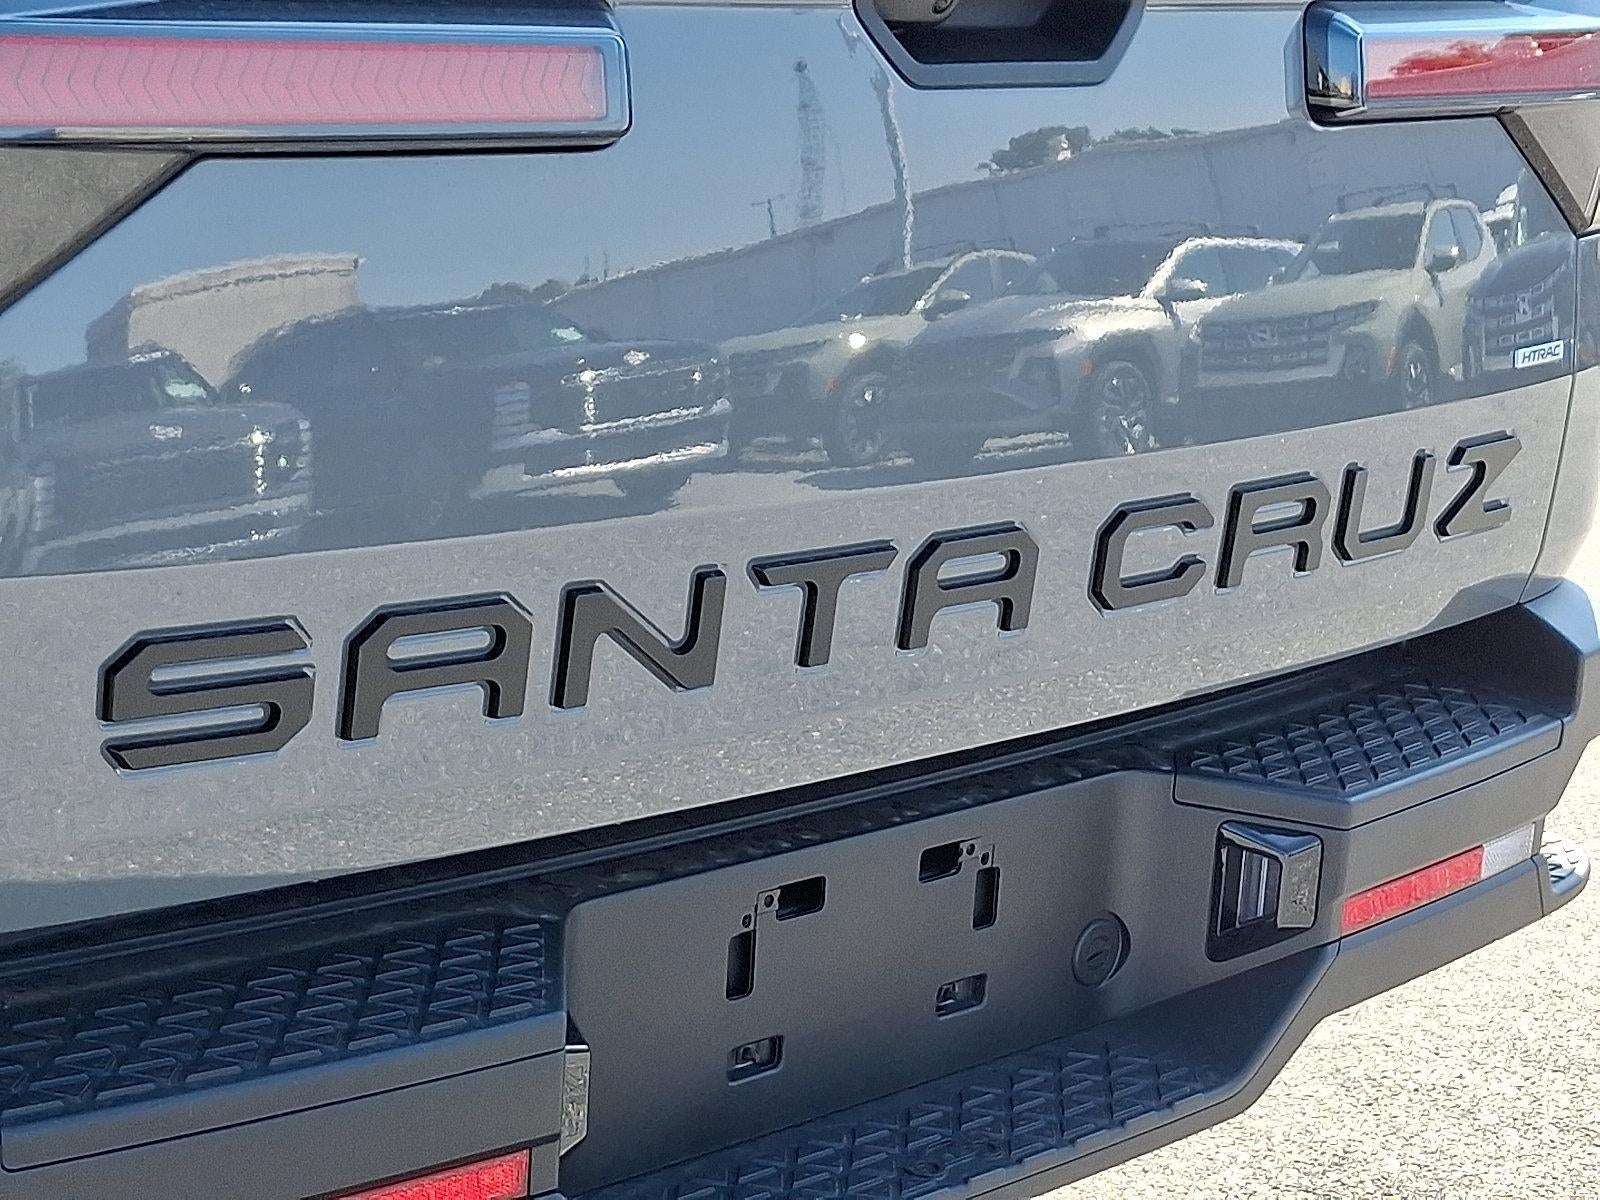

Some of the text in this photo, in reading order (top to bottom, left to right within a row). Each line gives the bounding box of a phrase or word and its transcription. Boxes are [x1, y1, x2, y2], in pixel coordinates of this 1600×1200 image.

[1521, 344, 1561, 364] HTRAC
[97, 429, 1522, 772] SANTA CRUZ
